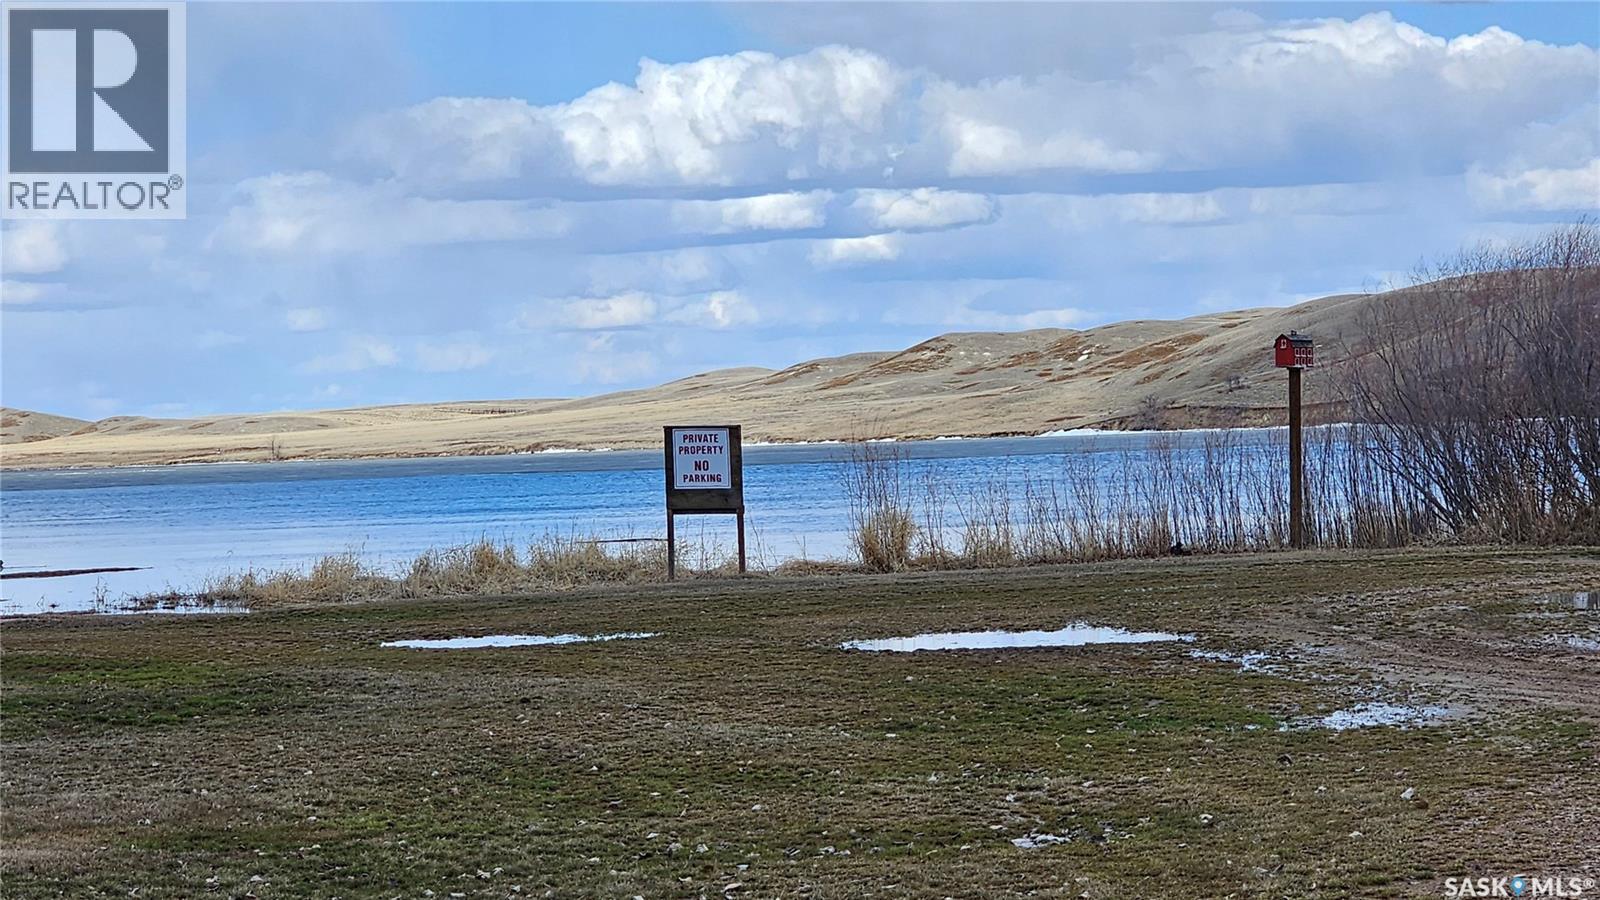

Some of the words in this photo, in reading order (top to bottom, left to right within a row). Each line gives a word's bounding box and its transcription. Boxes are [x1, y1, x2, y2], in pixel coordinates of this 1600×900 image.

[682, 433, 719, 443] PRIVATE
[678, 445, 724, 455] PROPERTY
[694, 460, 710, 471] NO
[682, 474, 722, 483] PARKING
